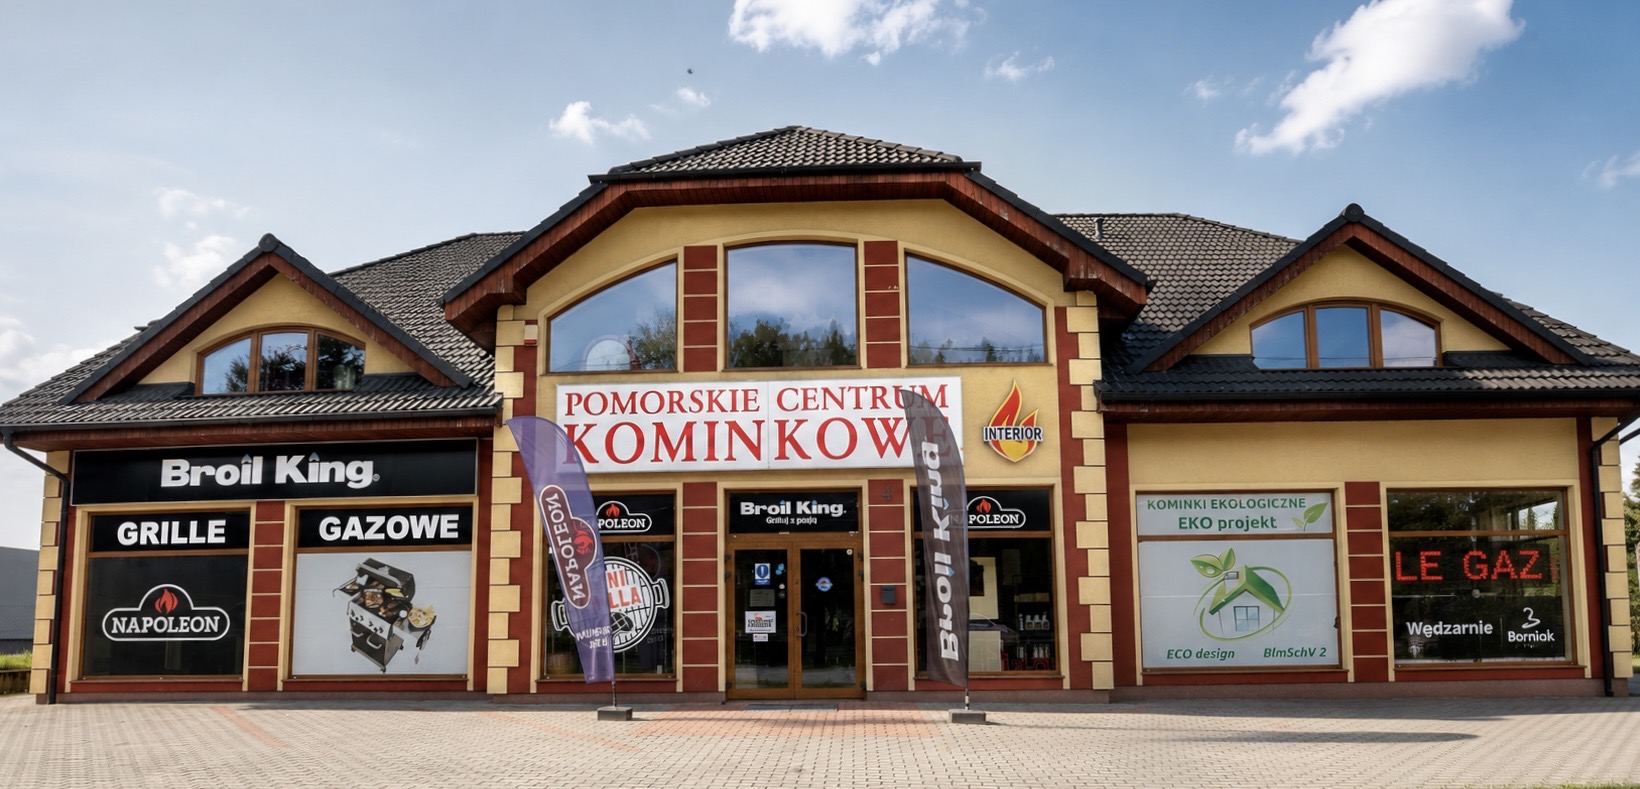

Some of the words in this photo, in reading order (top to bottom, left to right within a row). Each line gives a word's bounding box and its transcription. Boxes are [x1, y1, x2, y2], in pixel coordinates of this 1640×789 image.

[565, 388, 760, 416] POMORSKIE
[776, 383, 949, 412] CENTRUM
[562, 416, 950, 464] KOMINKOWE
[984, 426, 1043, 441] INTERIOR
[160, 454, 262, 488] Broil
[880, 484, 892, 500] 4
[740, 500, 791, 515] Broil
[1147, 499, 1207, 510] KOMINKI
[1211, 497, 1306, 510] EKOLOGICZNE
[319, 514, 460, 541] GAZOWE
[598, 518, 646, 529] POLEON
[968, 514, 1019, 525] POLEON
[1178, 516, 1213, 530] EKO
[1218, 515, 1277, 532] projekt
[117, 519, 226, 546] GRILLE
[112, 615, 220, 635] NAPOLEON
[1406, 620, 1493, 638] Wędzarnie
[1508, 629, 1555, 642] Borniak
[1166, 649, 1192, 660] ECO
[1196, 648, 1235, 661] design
[1319, 647, 1327, 658] 2
